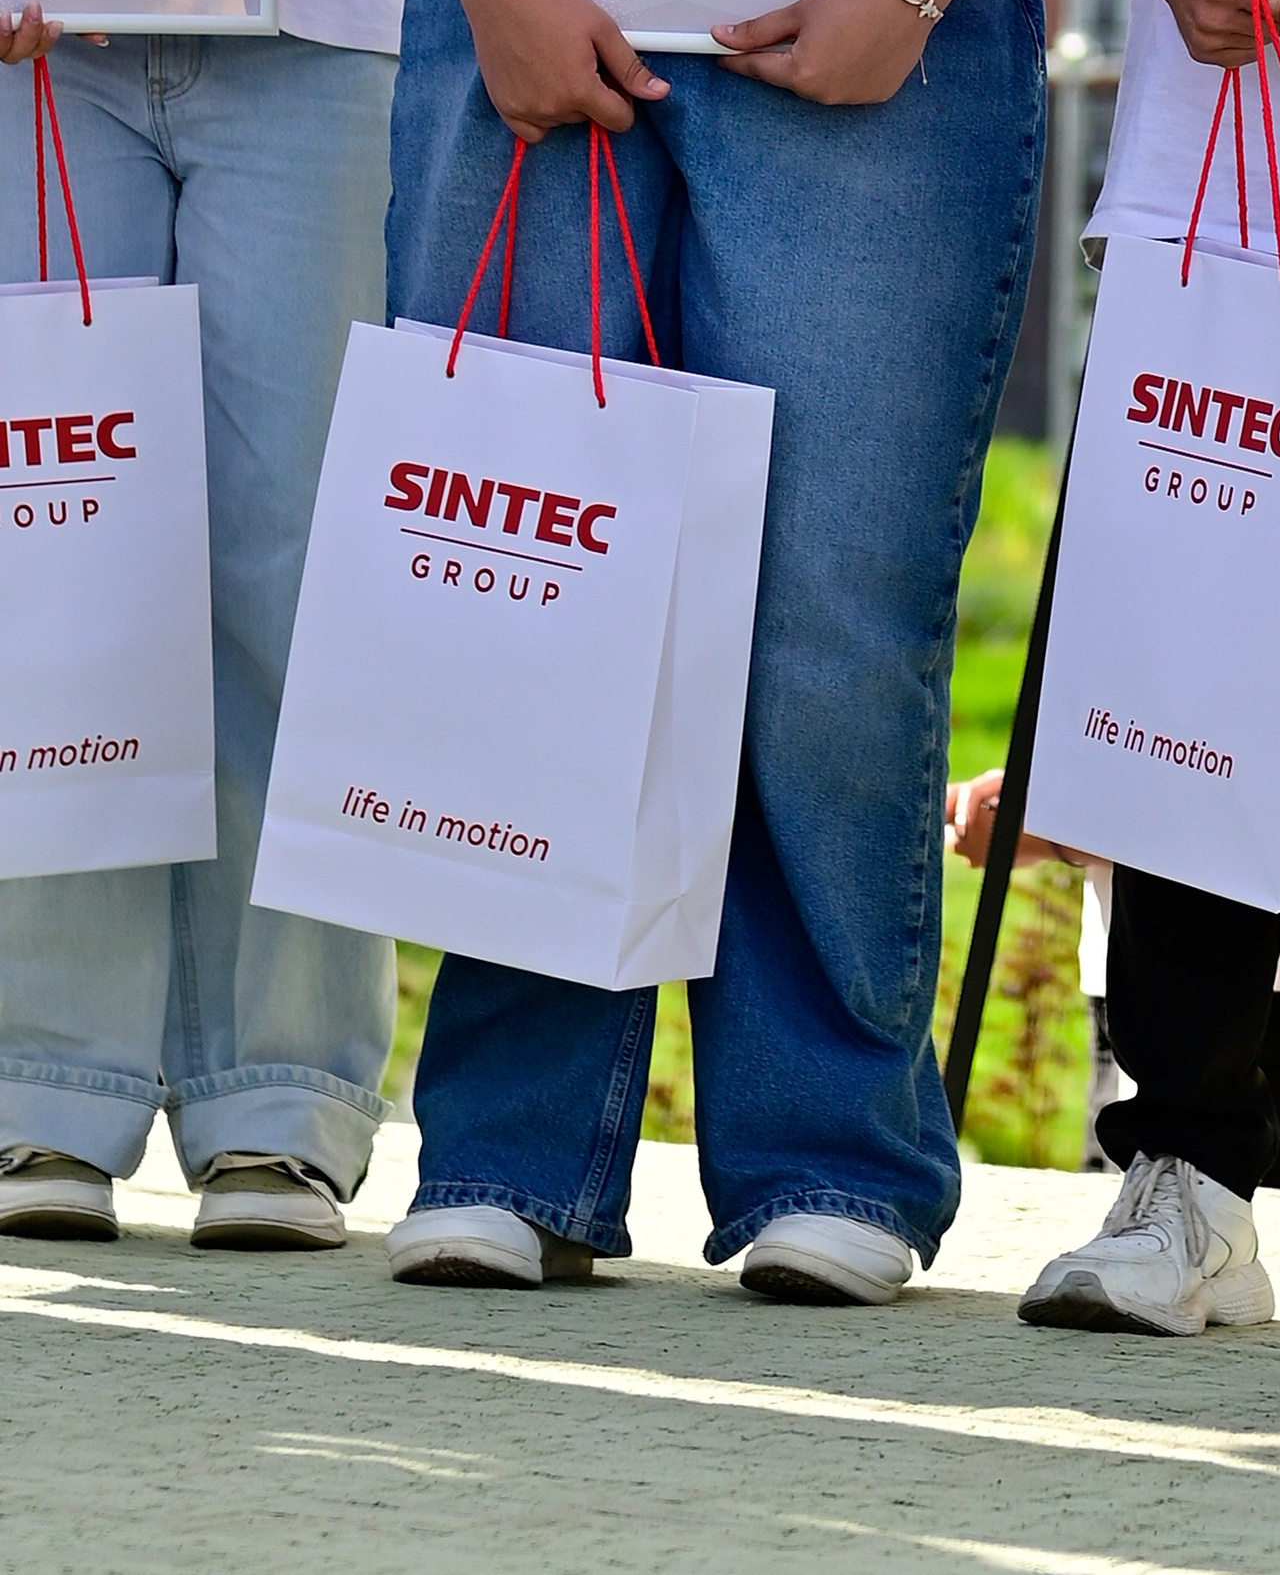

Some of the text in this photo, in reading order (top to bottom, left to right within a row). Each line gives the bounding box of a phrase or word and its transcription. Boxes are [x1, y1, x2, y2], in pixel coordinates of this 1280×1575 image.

[0, 411, 137, 468] TEC
[384, 462, 617, 554] SINTEC
[1144, 466, 1256, 516] GROUP
[410, 553, 560, 606] GROUP
[27, 734, 140, 771] motion
[1084, 708, 1234, 779] life in motion
[341, 786, 550, 862] life in motion
